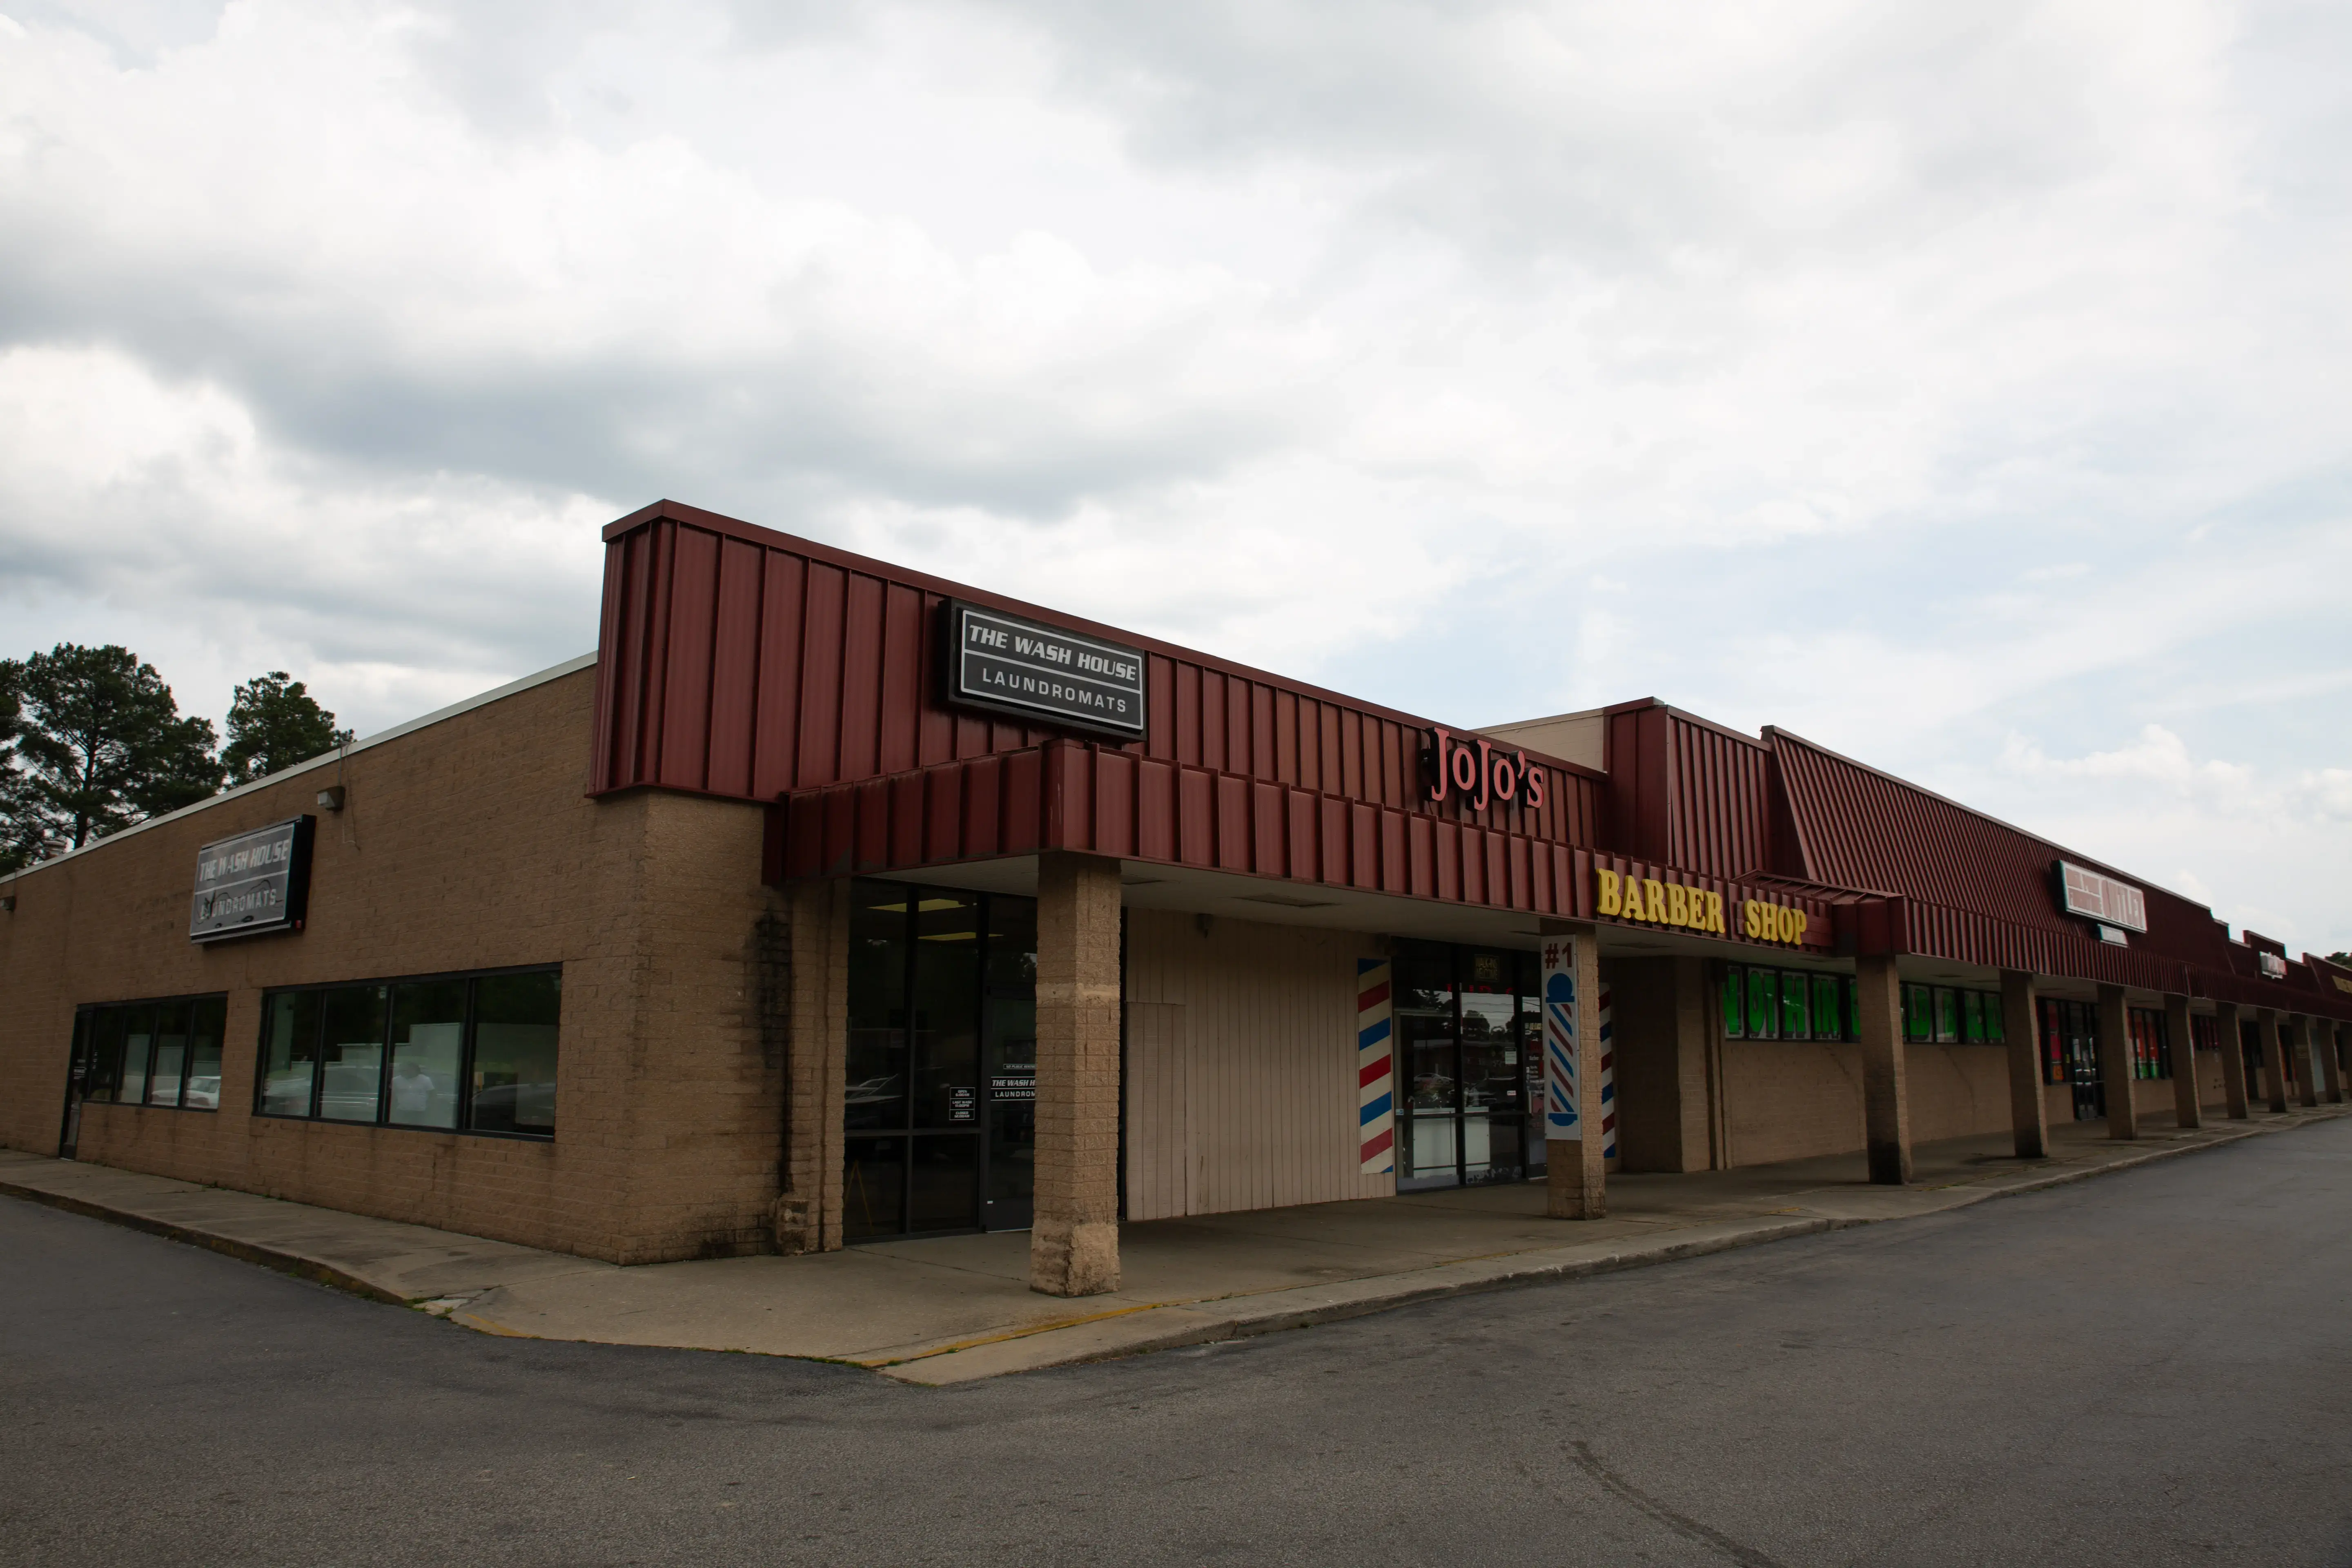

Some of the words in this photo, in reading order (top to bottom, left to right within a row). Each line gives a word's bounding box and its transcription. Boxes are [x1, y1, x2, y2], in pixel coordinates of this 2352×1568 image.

[970, 625, 1008, 648] THE
[1015, 636, 1071, 664] WASH
[1077, 653, 1136, 681] HOUSE
[983, 668, 1126, 713] LAUNDROMATS
[199, 860, 217, 882] THE
[218, 851, 249, 876] WASH
[250, 840, 290, 868] HOUSE
[1596, 868, 1726, 934] BARBER
[1744, 899, 1807, 945] SHOP
[1545, 942, 1572, 969] #1
